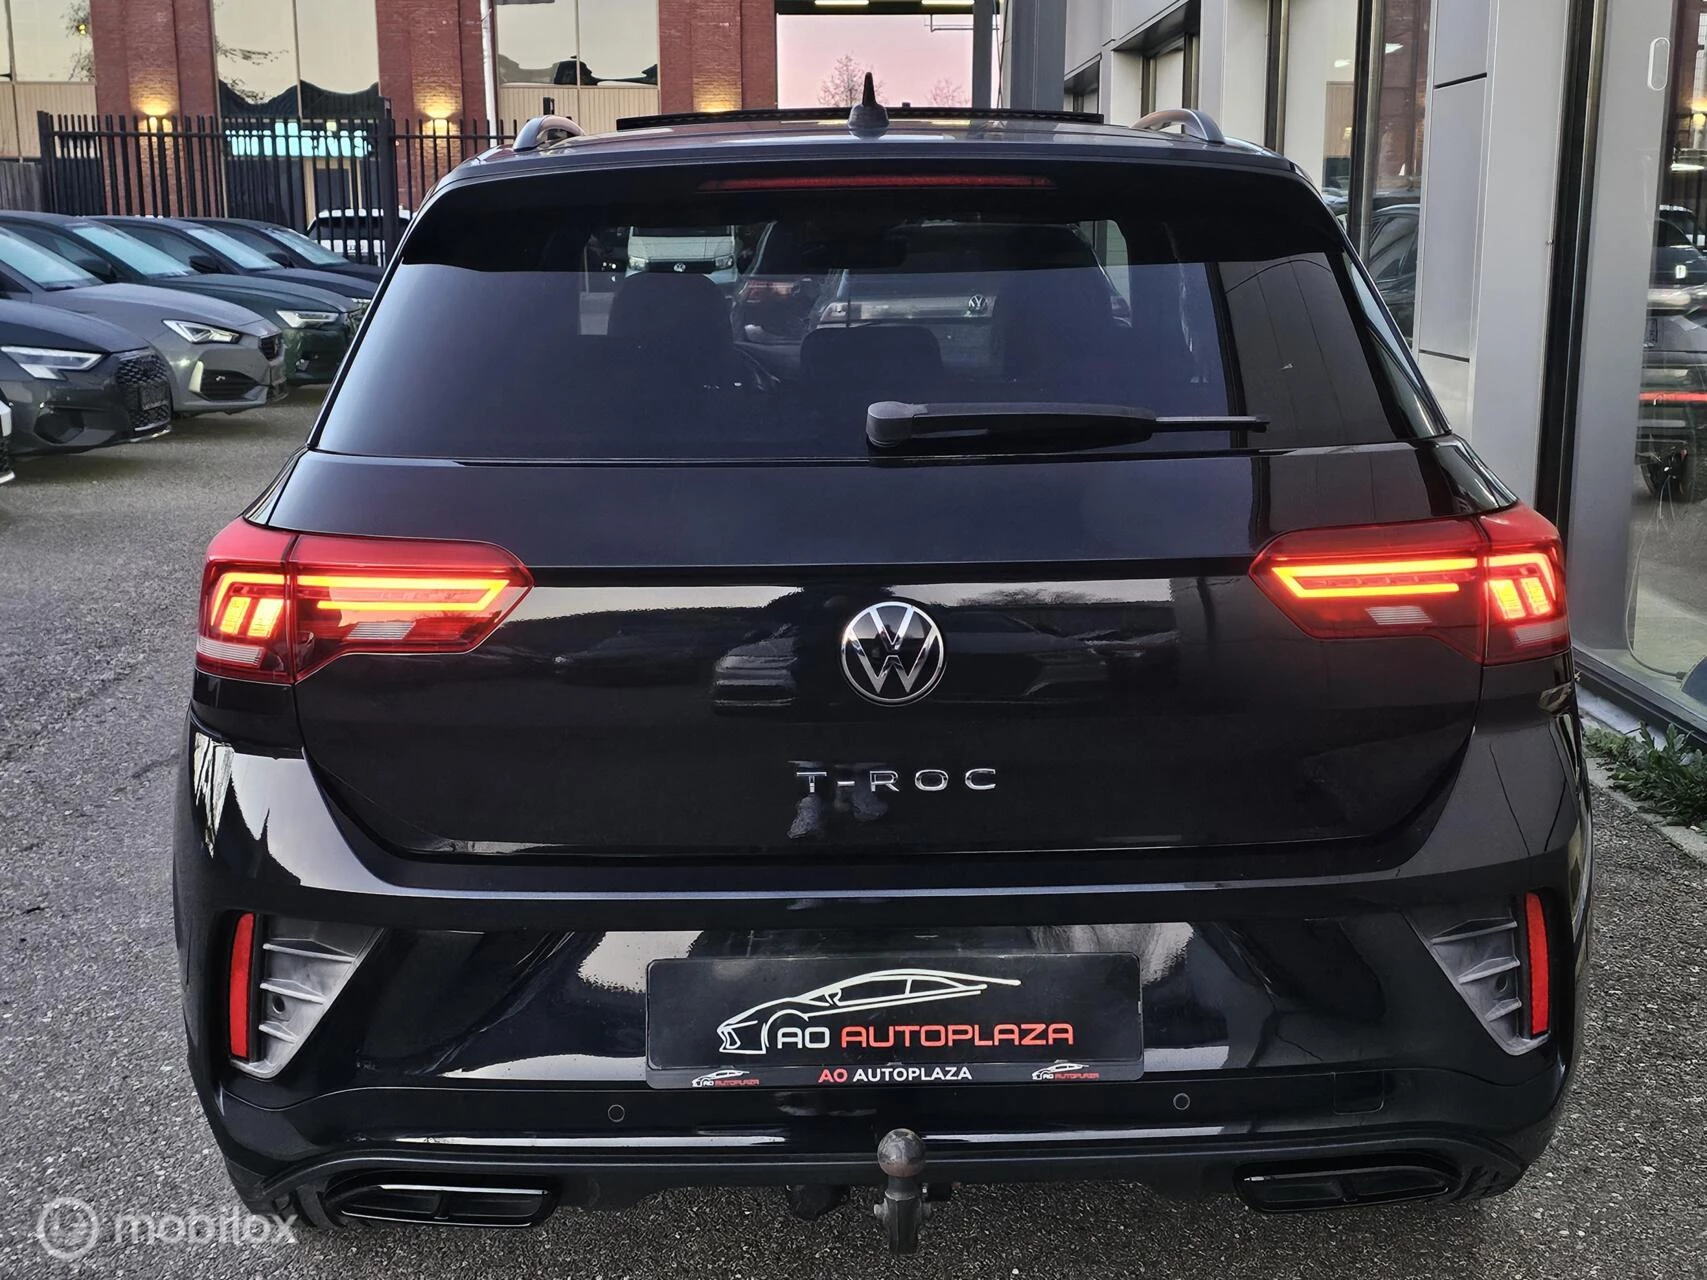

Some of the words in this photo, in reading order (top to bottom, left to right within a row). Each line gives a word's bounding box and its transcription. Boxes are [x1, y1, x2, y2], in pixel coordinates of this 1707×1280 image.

[796, 768, 996, 792] T-ROC
[777, 1026, 830, 1049] AO
[840, 1023, 1074, 1048] AUTOPLAZA
[818, 1068, 848, 1083] AO
[853, 1066, 972, 1082] AUTOPLAZA
